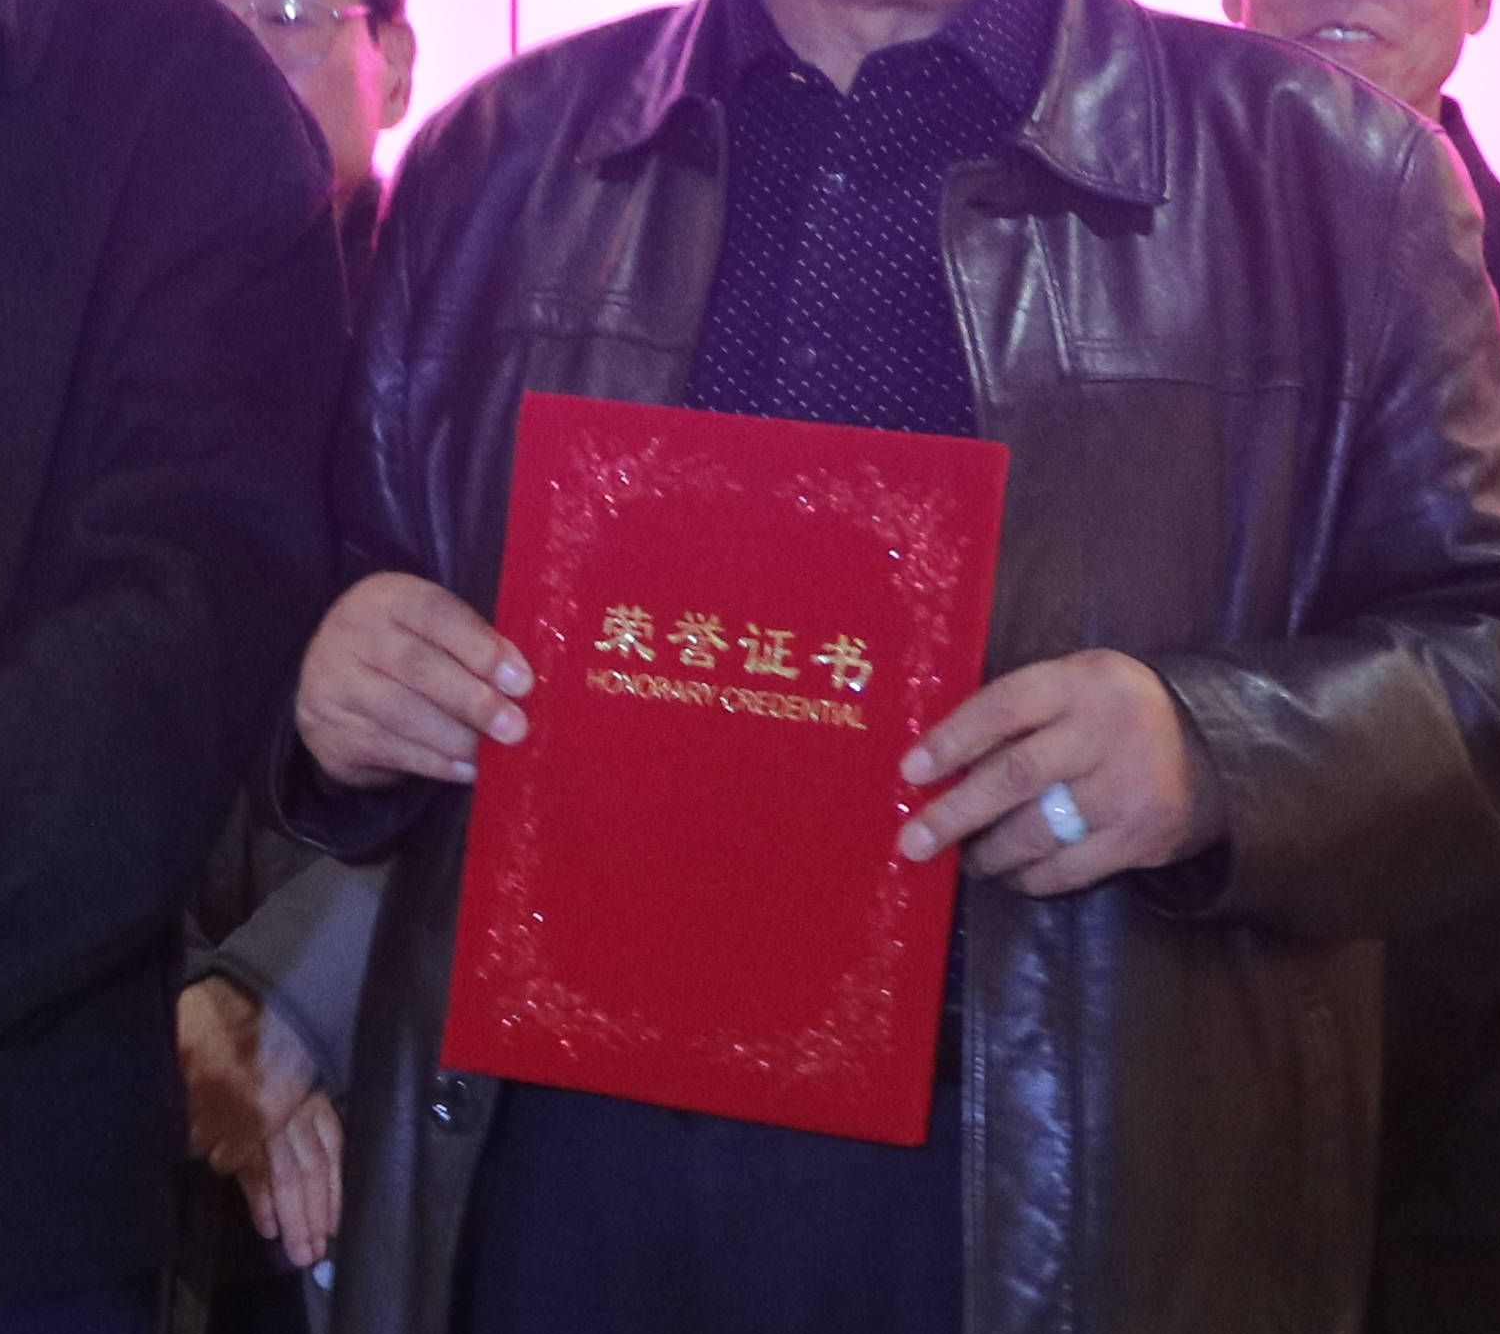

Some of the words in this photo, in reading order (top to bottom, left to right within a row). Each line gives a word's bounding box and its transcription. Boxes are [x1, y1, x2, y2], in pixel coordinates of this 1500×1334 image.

[594, 603, 876, 694] 荣誉证书
[587, 668, 718, 708] HONORARY
[718, 685, 868, 731] CREDENTIAL
